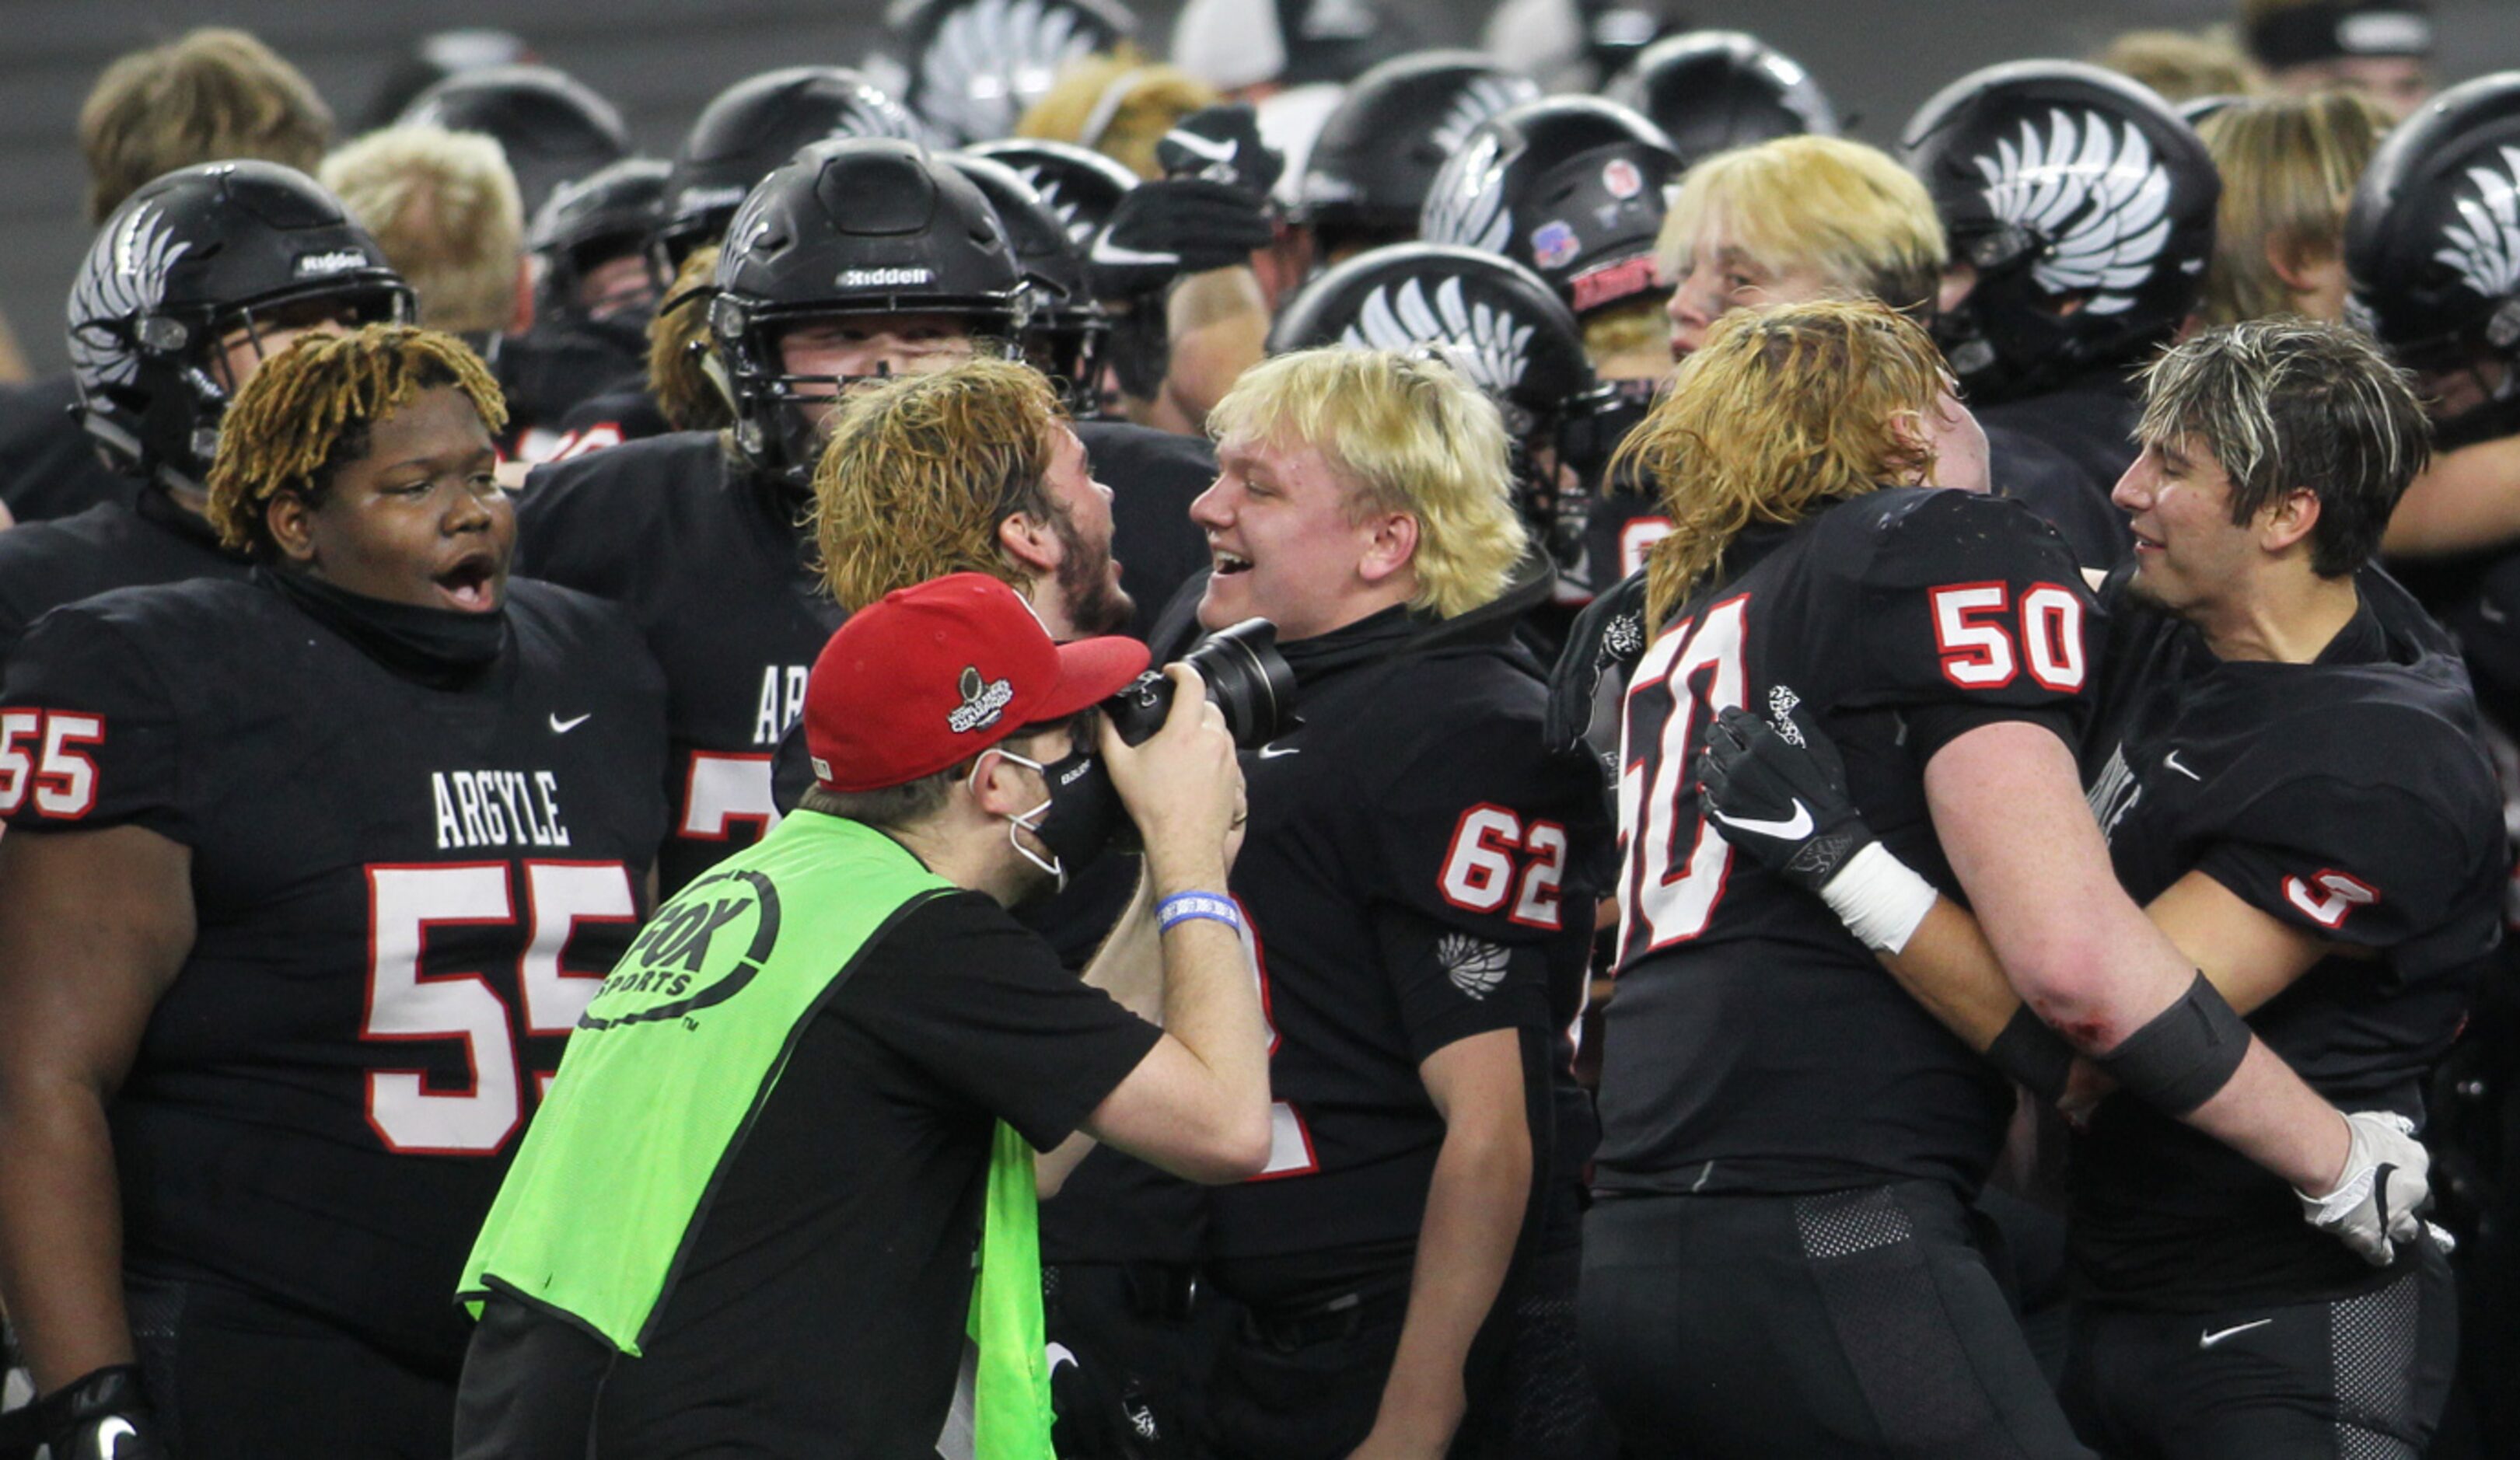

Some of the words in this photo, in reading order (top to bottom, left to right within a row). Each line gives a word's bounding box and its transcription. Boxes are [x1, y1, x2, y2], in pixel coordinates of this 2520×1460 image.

[1928, 579, 2089, 693] 50
[0, 706, 107, 821] 55
[431, 770, 570, 849] ARGYLE
[1613, 592, 1751, 978] 50
[1436, 801, 1568, 931] 62
[594, 970, 692, 1001] SPORTS
[619, 897, 755, 973] FOX
